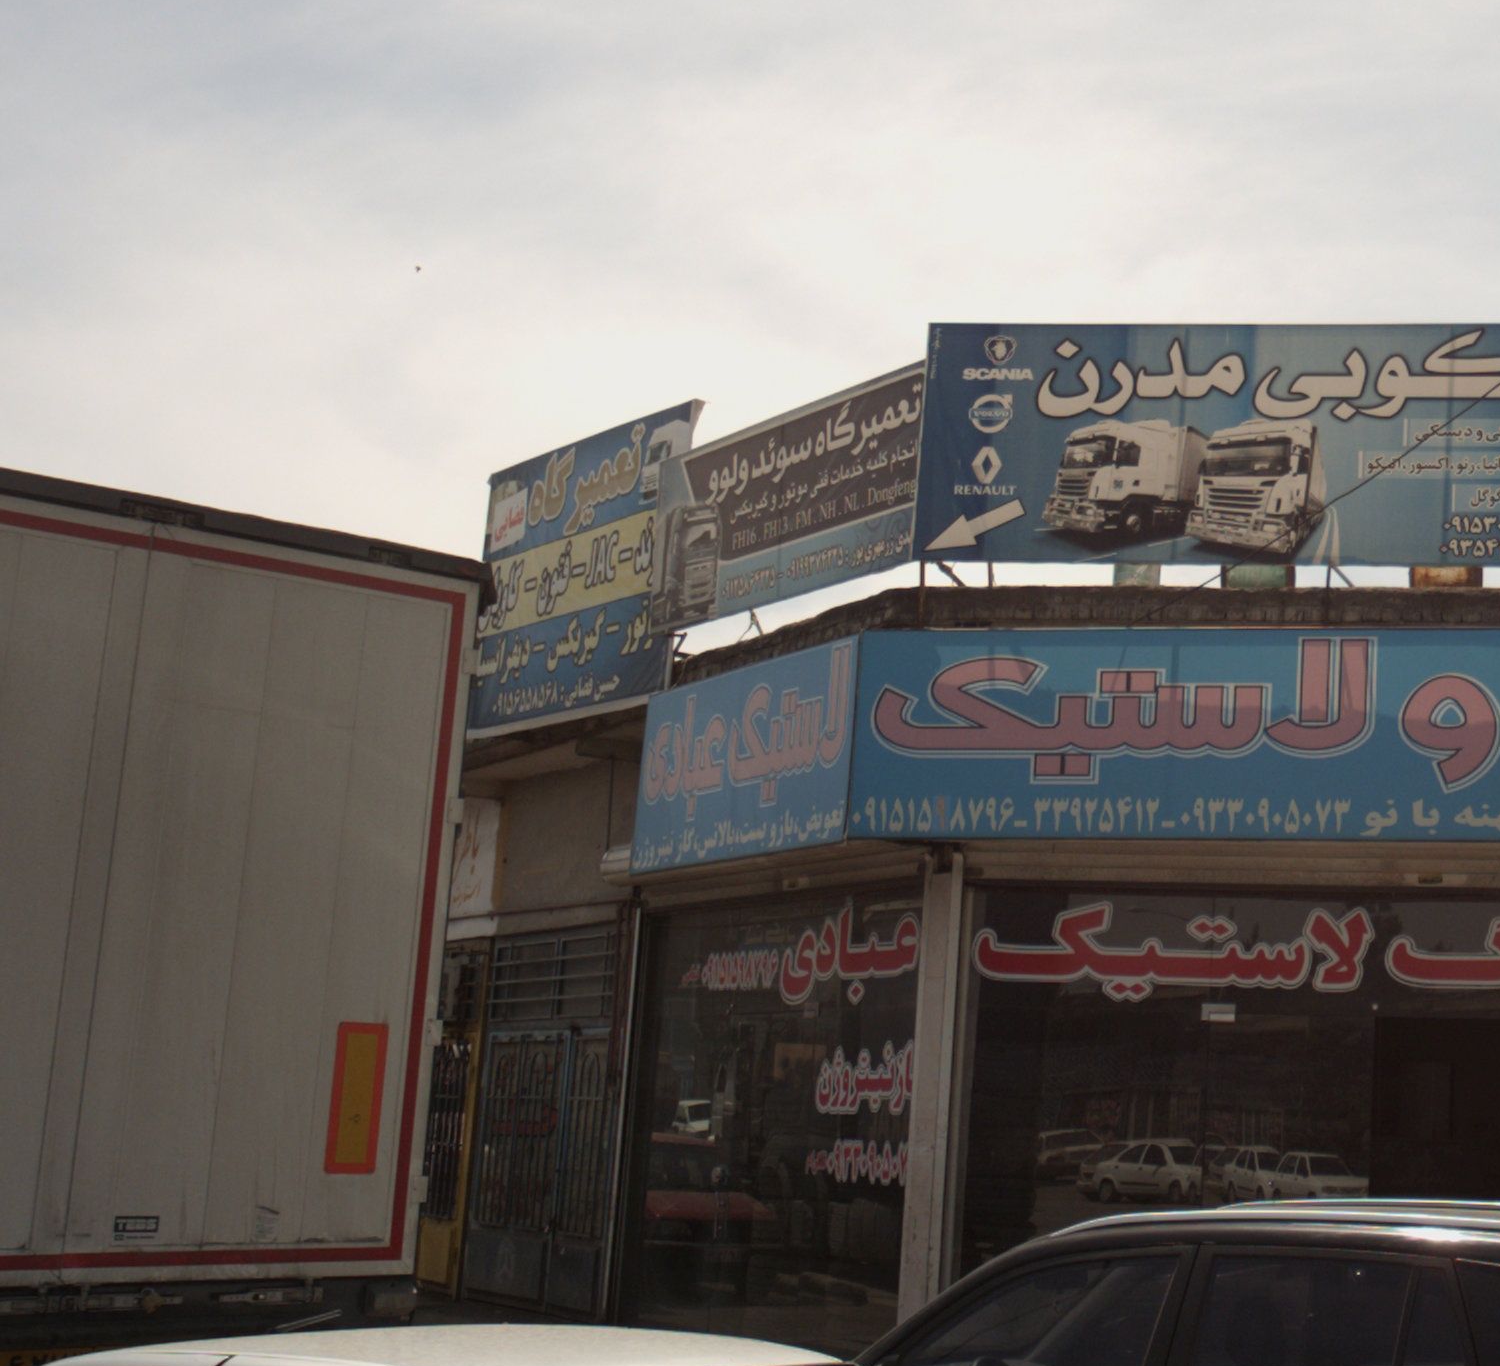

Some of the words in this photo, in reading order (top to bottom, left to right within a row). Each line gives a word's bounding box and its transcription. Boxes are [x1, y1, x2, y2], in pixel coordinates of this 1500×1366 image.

[962, 367, 1034, 381] SCANIA
[1036, 337, 1247, 419] مدرن
[973, 409, 1010, 419] VOLVO
[1414, 423, 1474, 443] دیسکی
[953, 484, 1018, 496] RENAULT
[584, 529, 620, 591] JAC
[870, 635, 1380, 786] لاستیک
[642, 694, 728, 823] عبادی
[1360, 799, 1400, 836] نو
[1410, 798, 1441, 835] با
[779, 899, 921, 1005] عبادی
[973, 901, 1374, 1002] لاستیک
